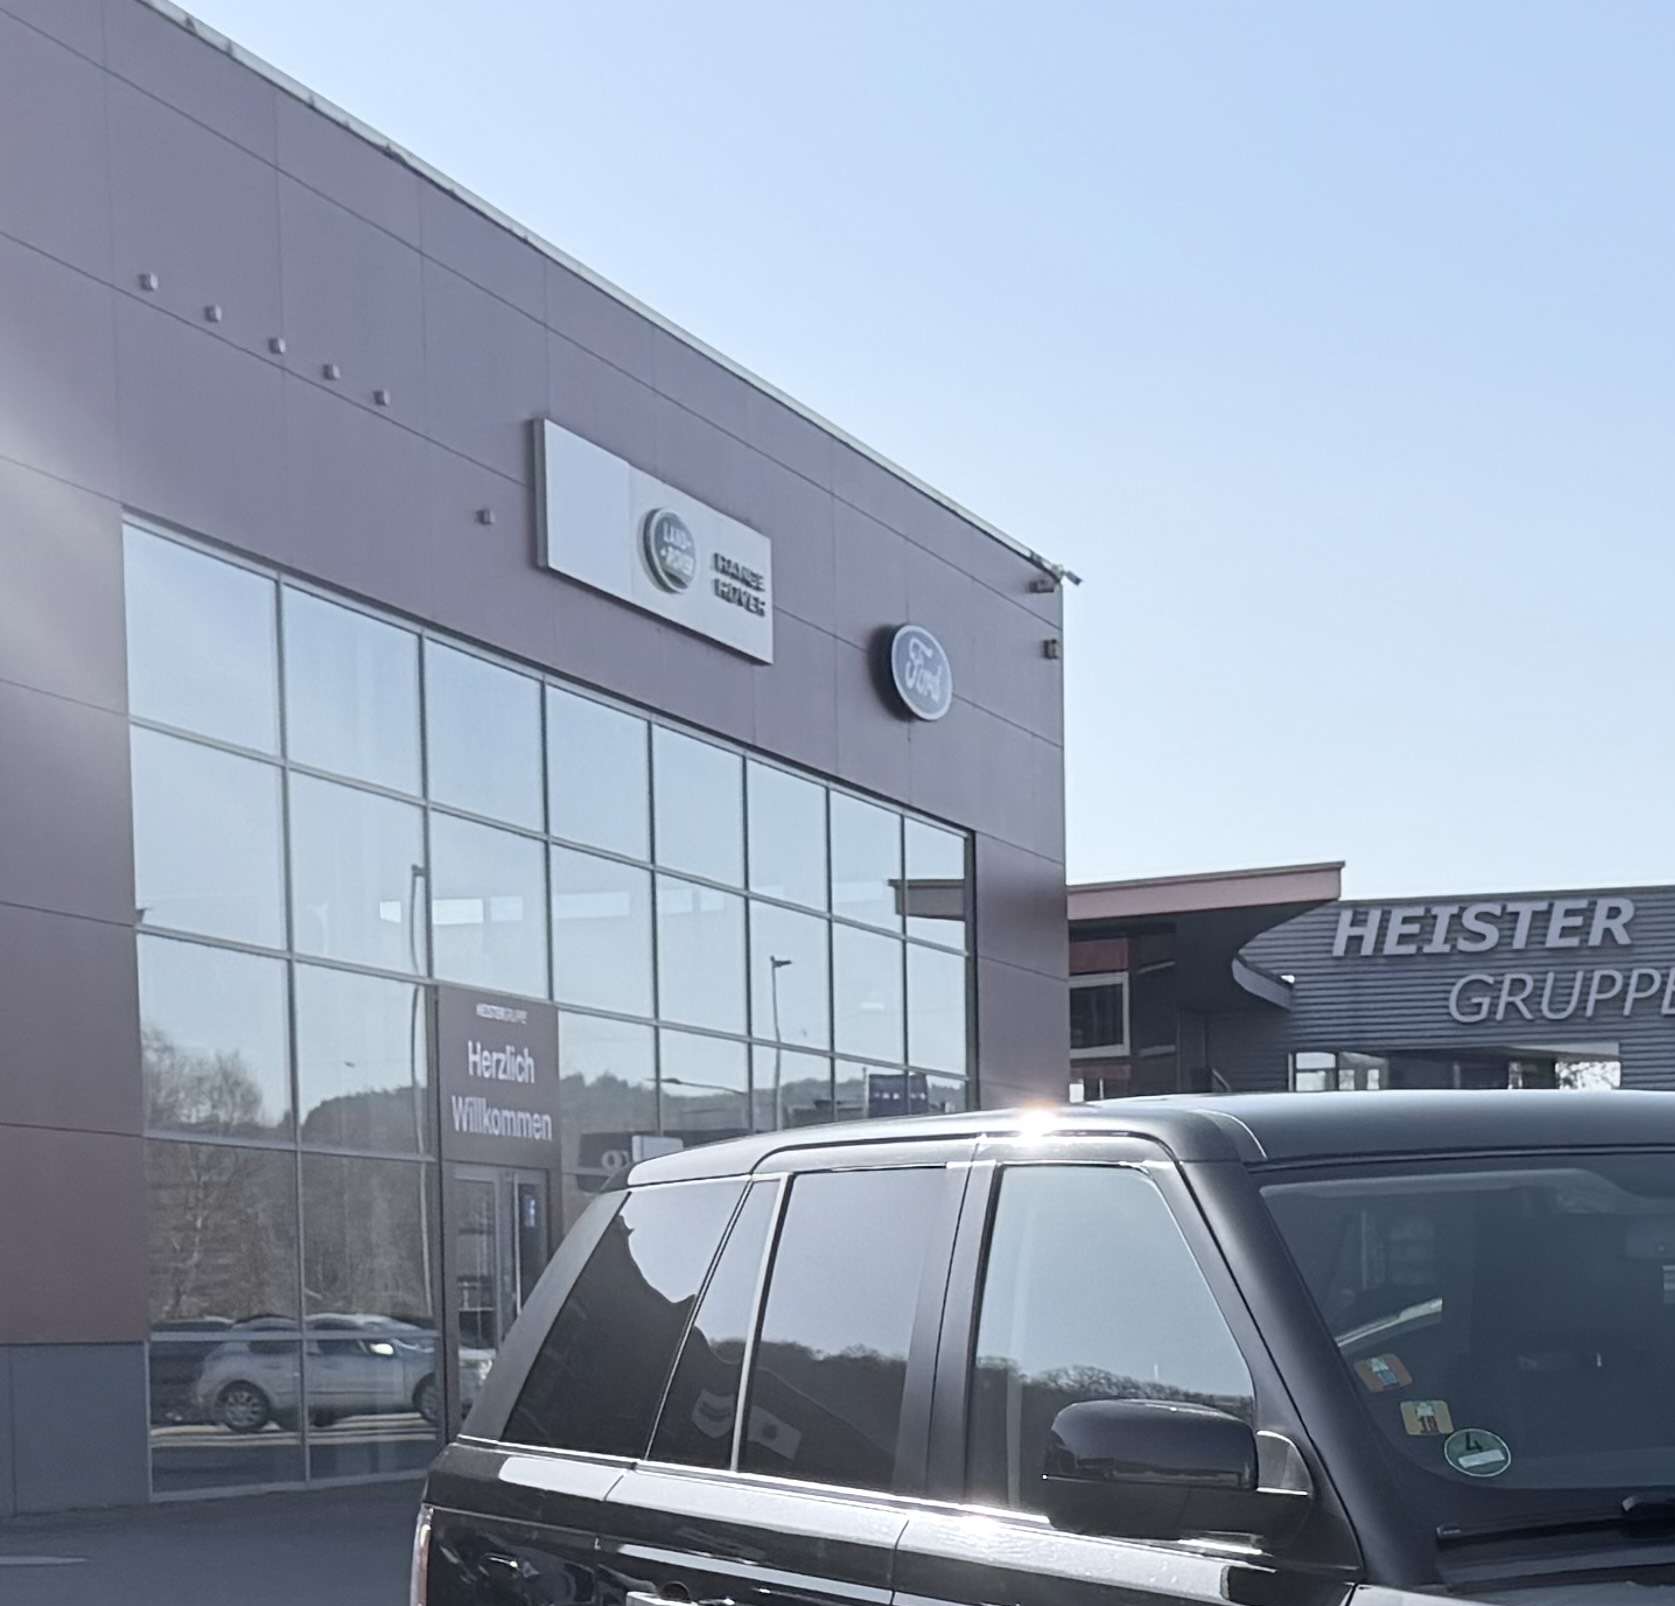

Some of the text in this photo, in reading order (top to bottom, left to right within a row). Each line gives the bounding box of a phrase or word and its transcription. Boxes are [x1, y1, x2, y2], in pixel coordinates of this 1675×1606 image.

[905, 637, 942, 703] Ford
[1332, 898, 1635, 957] HEISTER
[467, 1040, 535, 1084] Herzlich
[451, 1095, 553, 1141] Willkommen
